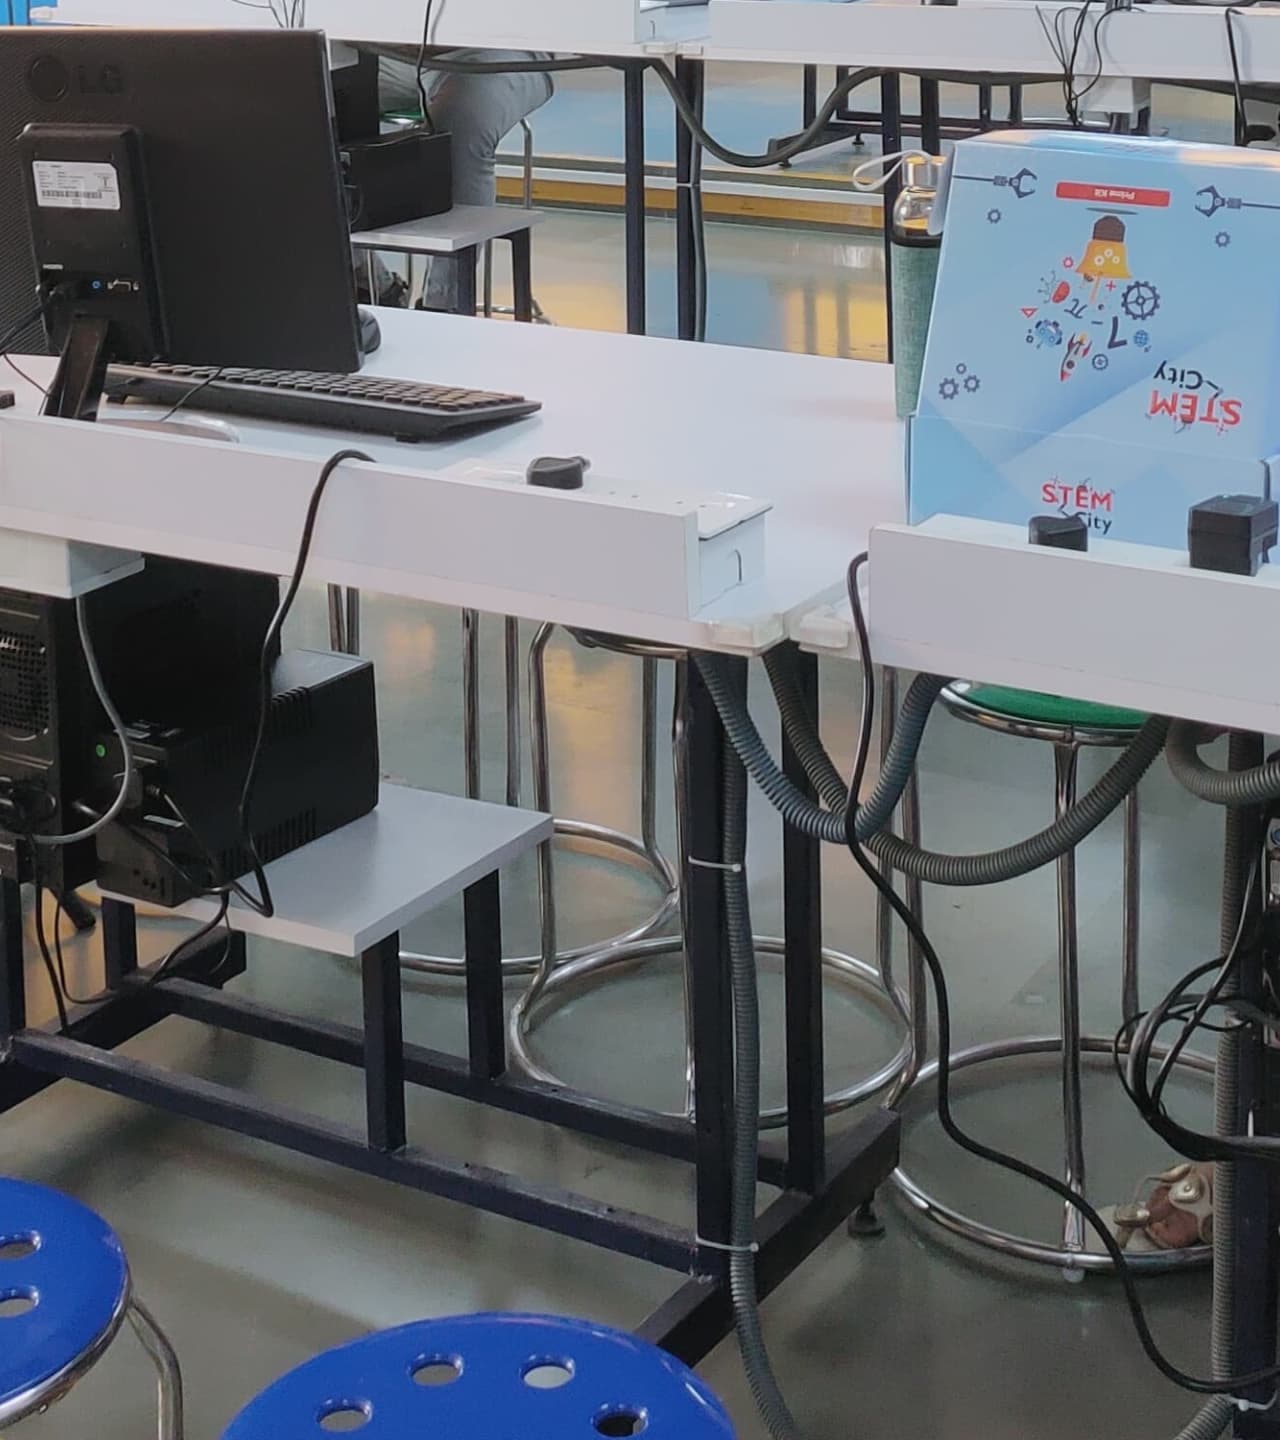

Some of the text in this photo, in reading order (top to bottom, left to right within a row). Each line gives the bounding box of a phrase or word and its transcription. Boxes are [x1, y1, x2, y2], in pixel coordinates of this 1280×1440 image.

[1153, 360, 1204, 390] City
[1149, 389, 1242, 426] STEM
[1042, 483, 1112, 512] STEM
